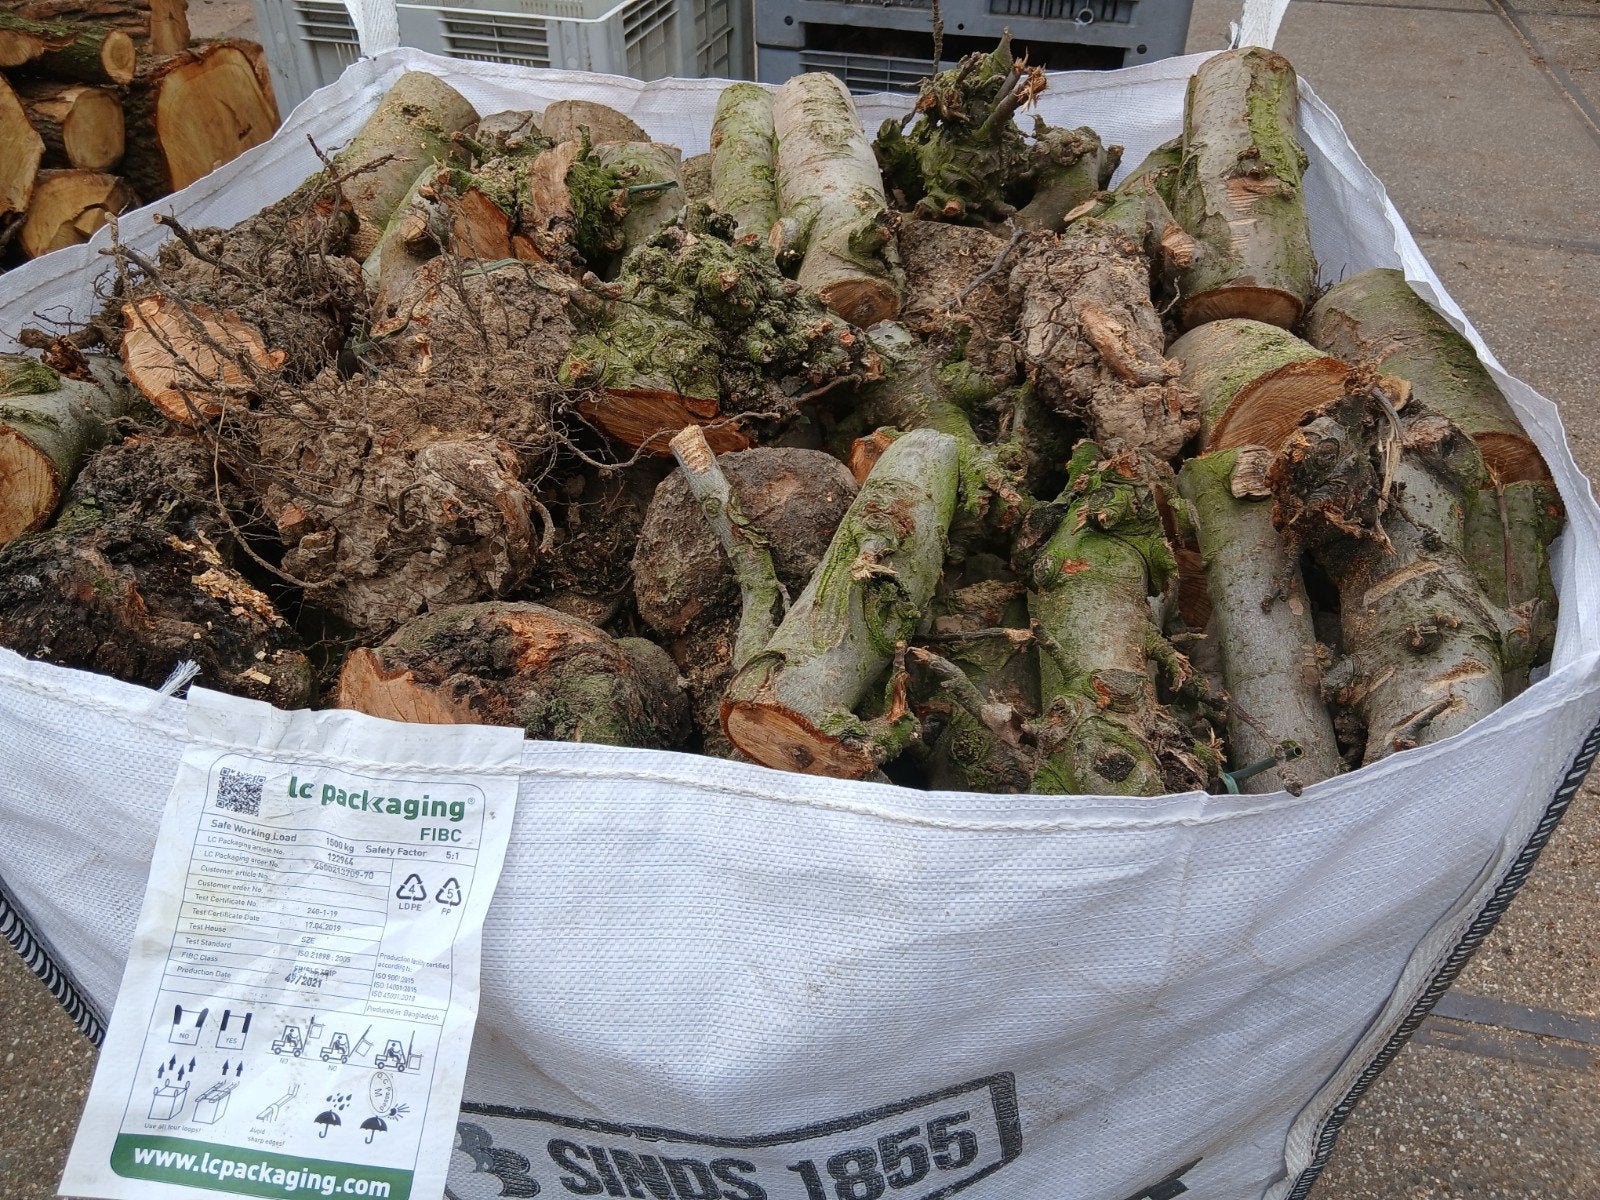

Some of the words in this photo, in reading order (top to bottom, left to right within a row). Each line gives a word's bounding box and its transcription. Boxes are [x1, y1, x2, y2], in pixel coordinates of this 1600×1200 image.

[288, 776, 315, 799] lc
[321, 783, 465, 822] packaging
[210, 819, 232, 830] Safe
[234, 823, 271, 842] Working
[272, 831, 298, 843] Load
[420, 827, 462, 842] FIBC
[207, 835, 217, 844] LC
[218, 836, 252, 852] Packaging
[251, 844, 273, 854] article
[273, 847, 286, 856] No.
[326, 837, 343, 850] 1500
[344, 842, 355, 854] kg
[365, 844, 394, 857] Safety
[397, 847, 428, 858] Factor
[204, 849, 214, 858] LC
[214, 851, 250, 865] Packaging
[251, 858, 268, 868] order
[269, 860, 280, 869] No.
[327, 852, 354, 866] 122964
[445, 850, 460, 861] 5:1
[200, 864, 234, 876] Customer
[235, 868, 257, 878] article
[197, 879, 231, 889] Customer
[232, 883, 251, 892] order
[195, 893, 209, 901] Test
[210, 896, 246, 906] Certificate
[398, 902, 422, 912] LDPE
[440, 907, 452, 916] PP
[192, 907, 207, 916] Test
[207, 909, 243, 920] Certificate
[244, 913, 260, 922] Date
[190, 922, 203, 930] Test
[204, 924, 227, 933] House
[185, 937, 200, 945] Test
[200, 938, 232, 949] Standard
[301, 936, 315, 944] SZE
[181, 951, 199, 961] FIBC
[199, 954, 219, 962] Class
[297, 949, 309, 958] ISO
[176, 965, 214, 976] Production
[215, 970, 232, 978] Date
[375, 972, 386, 980] ISO
[373, 981, 384, 989] ISO
[371, 990, 383, 998] ISO
[366, 1004, 394, 1015] Produced
[403, 1009, 439, 1021] Bangladesh
[179, 1032, 189, 1040] NO
[225, 1037, 238, 1045] YES
[279, 1057, 289, 1065] NO
[327, 1064, 338, 1072] NO
[144, 1122, 157, 1130] Use
[249, 1126, 266, 1135] Avoid
[247, 1136, 264, 1145] sharp
[546, 1137, 768, 1200] SINDS
[786, 1111, 979, 1200] 1855
[134, 1147, 391, 1198] www.lcpackaging.com
